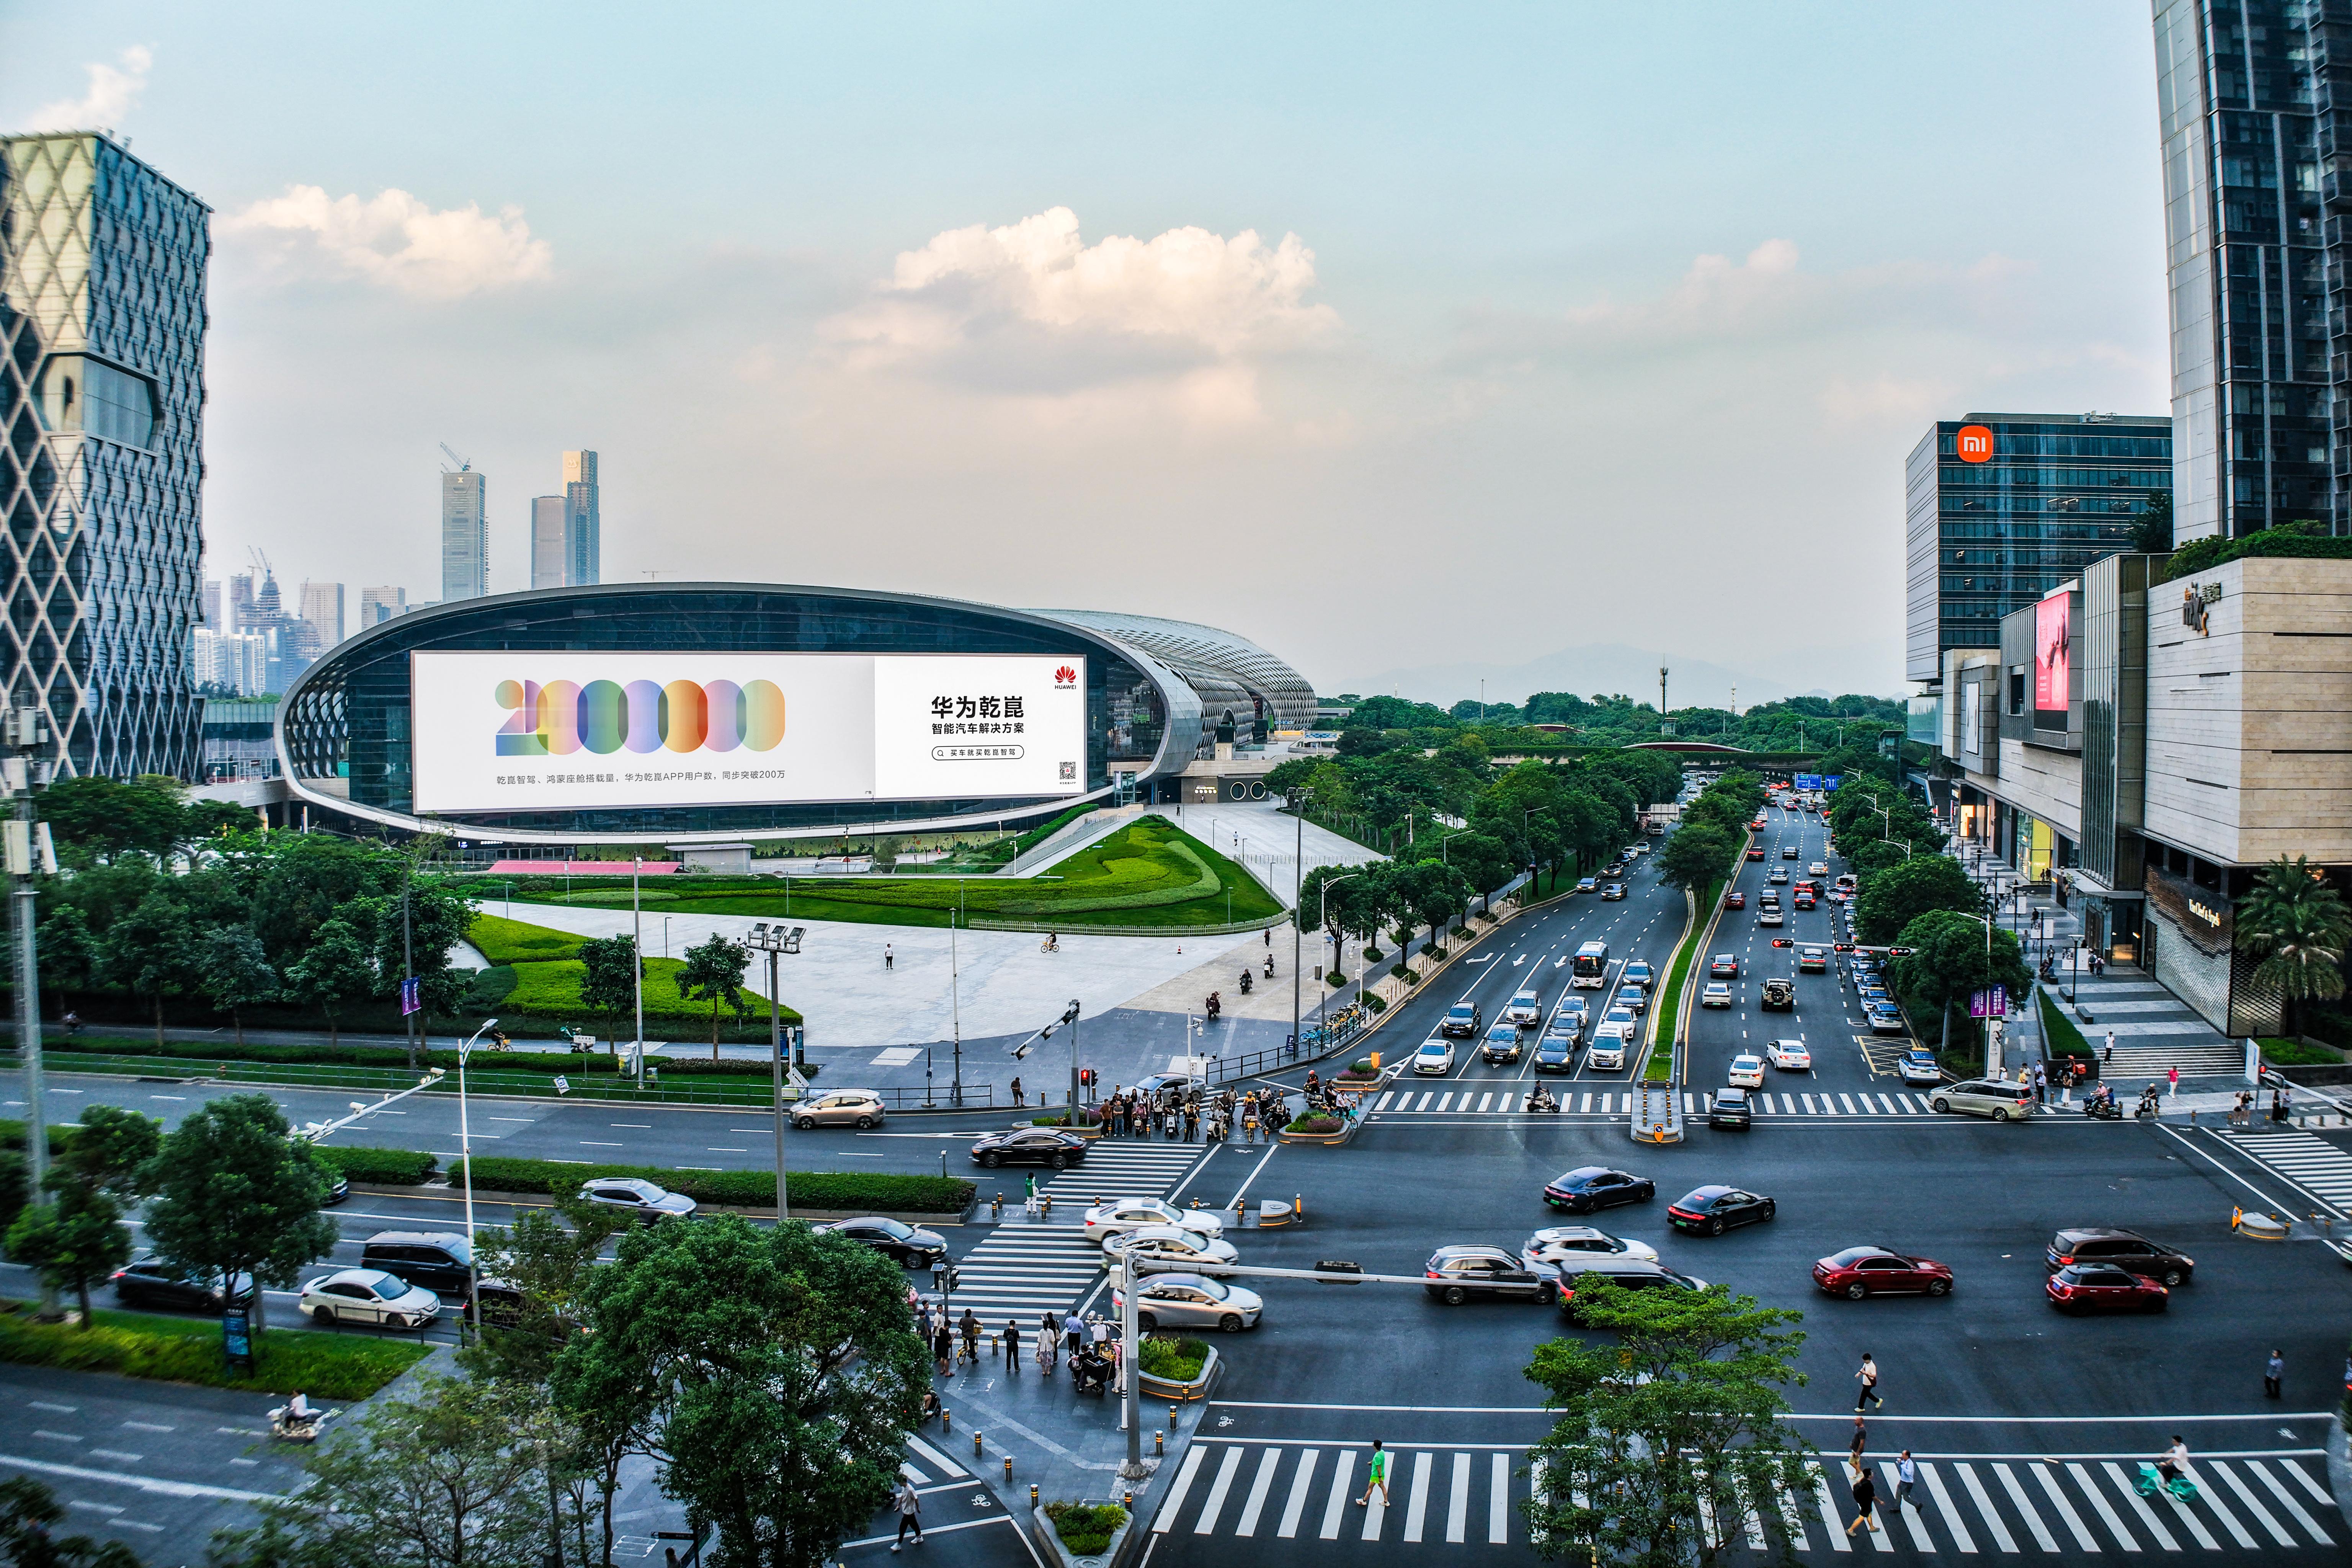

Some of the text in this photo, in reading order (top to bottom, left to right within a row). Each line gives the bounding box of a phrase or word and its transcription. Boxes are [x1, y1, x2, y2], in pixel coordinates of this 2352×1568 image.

[931, 696, 1024, 719] 华为乾崑
[932, 722, 1024, 735] 智能汽车解决方案
[951, 748, 1015, 756] 买车就买乾崑智驾
